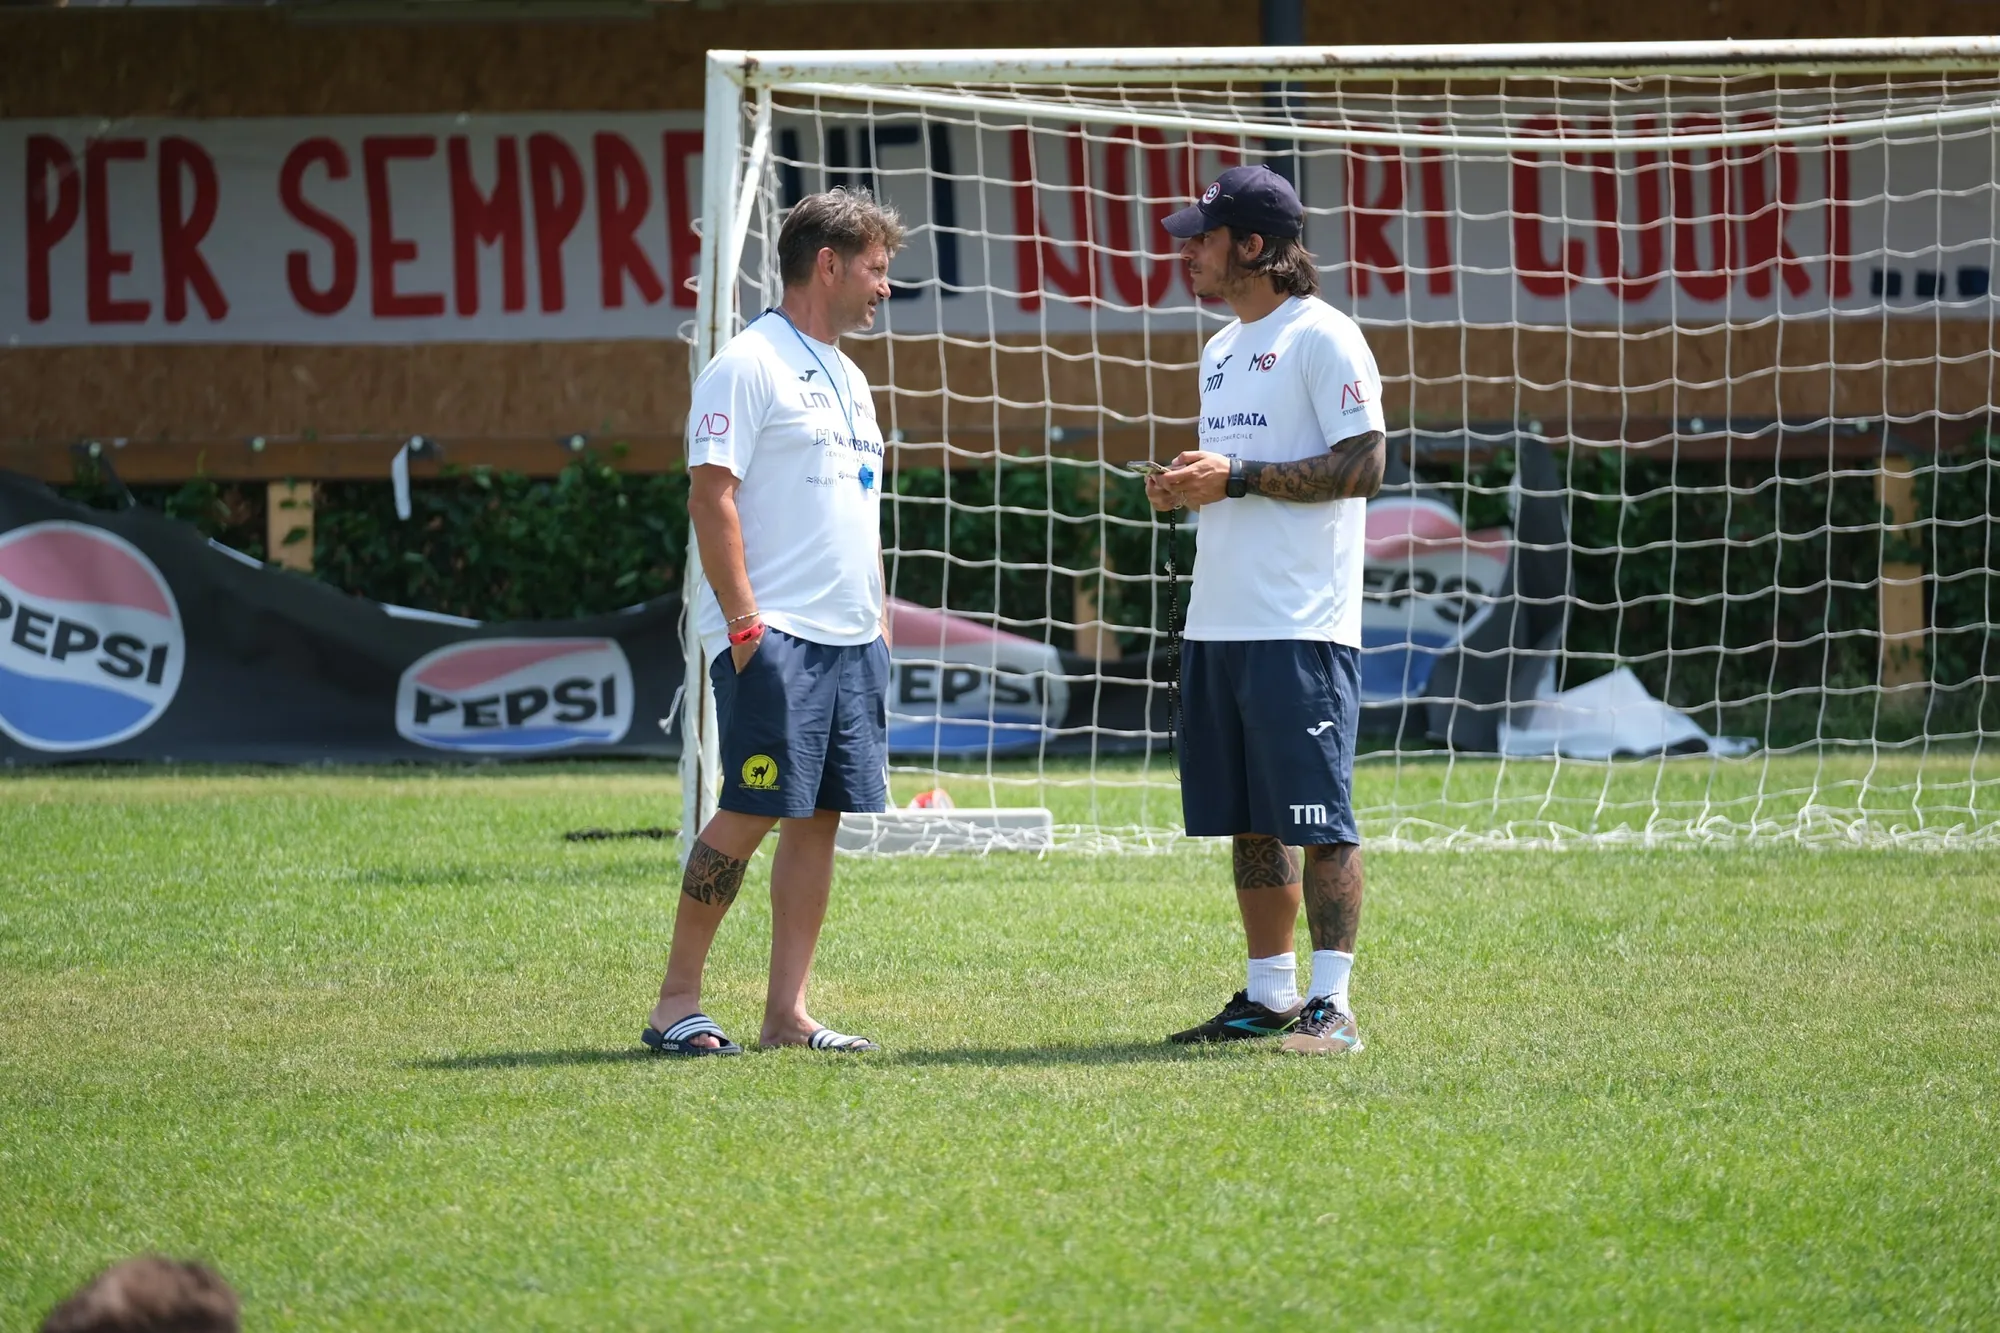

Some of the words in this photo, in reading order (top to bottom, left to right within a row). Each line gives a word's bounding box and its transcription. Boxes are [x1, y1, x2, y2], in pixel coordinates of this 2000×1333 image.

[25, 133, 231, 326] PER
[276, 129, 704, 319] SEMPRE
[1009, 117, 1454, 314] NOSRI
[1206, 416, 1226, 430] VAL
[846, 437, 884, 458] VBRATA
[891, 661, 1053, 706] EPSI
[414, 672, 617, 729] PEPSI
[1289, 803, 1328, 825] TM
[661, 1042, 680, 1051] adidas
